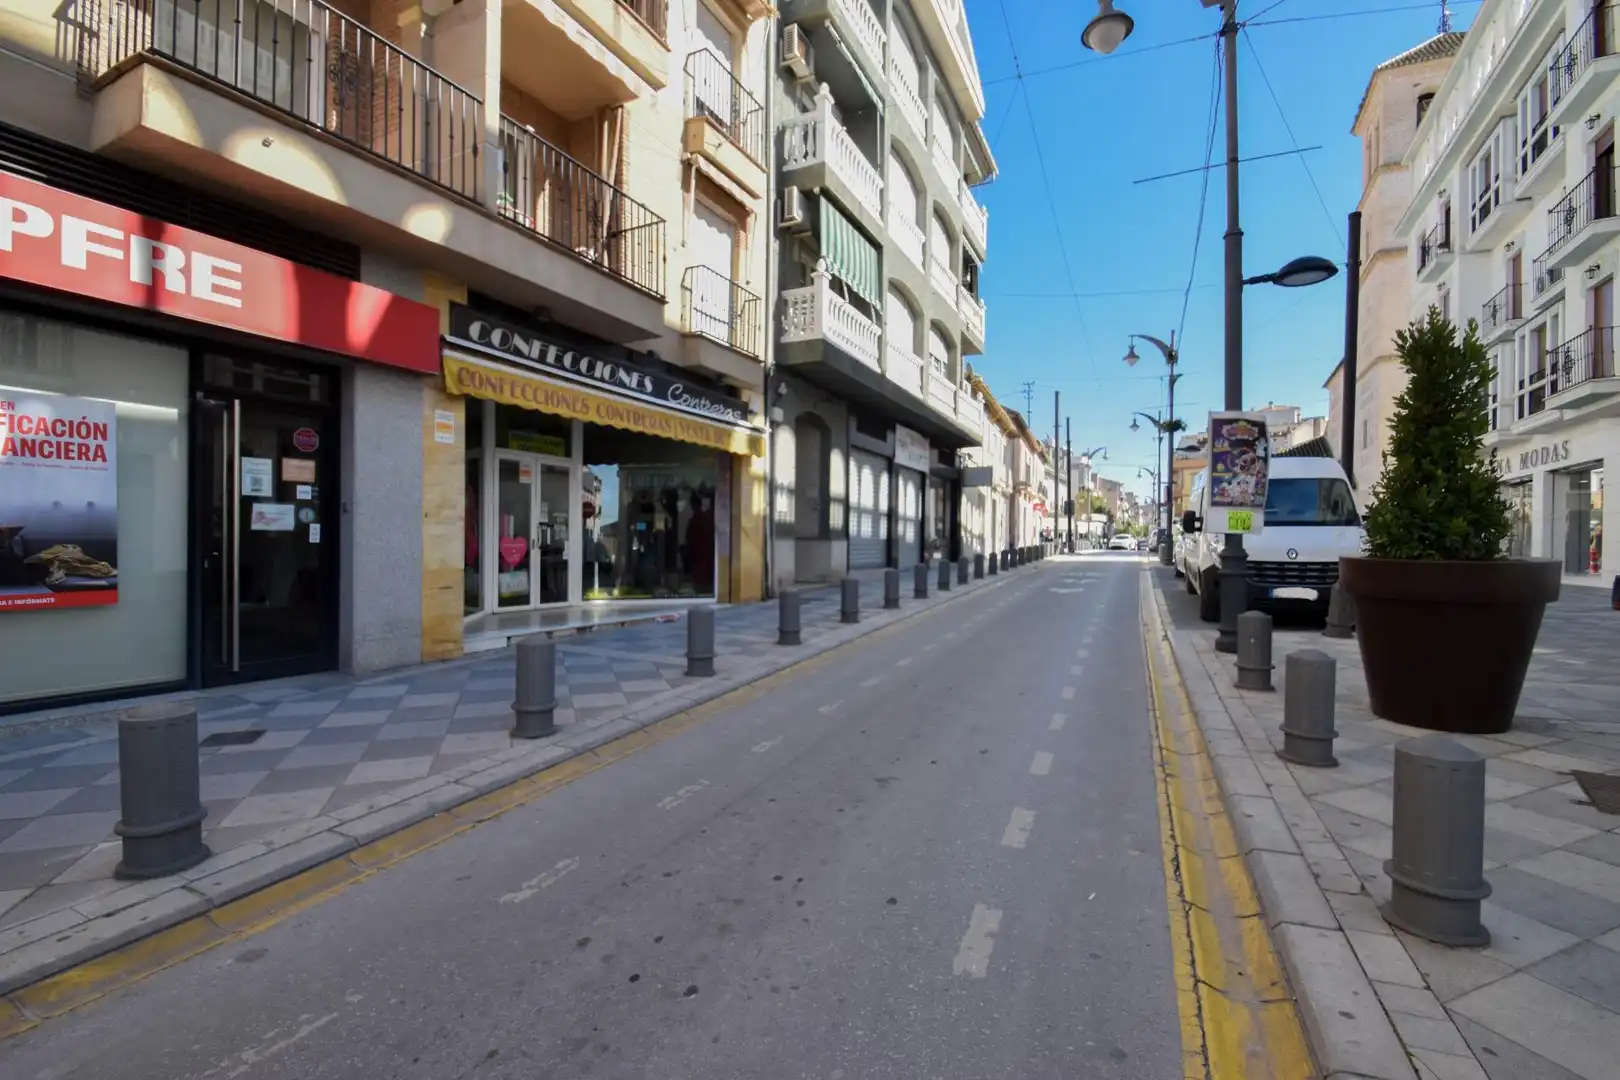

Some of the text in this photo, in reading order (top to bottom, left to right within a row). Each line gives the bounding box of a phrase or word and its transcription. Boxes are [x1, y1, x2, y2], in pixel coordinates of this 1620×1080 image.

[0, 196, 242, 308] PFRE
[457, 366, 590, 415] CONFECCIONES
[469, 320, 741, 421] CONFECCIONES Contreras
[2, 437, 107, 462] ANCIERA
[1520, 440, 1569, 470] MODAS
